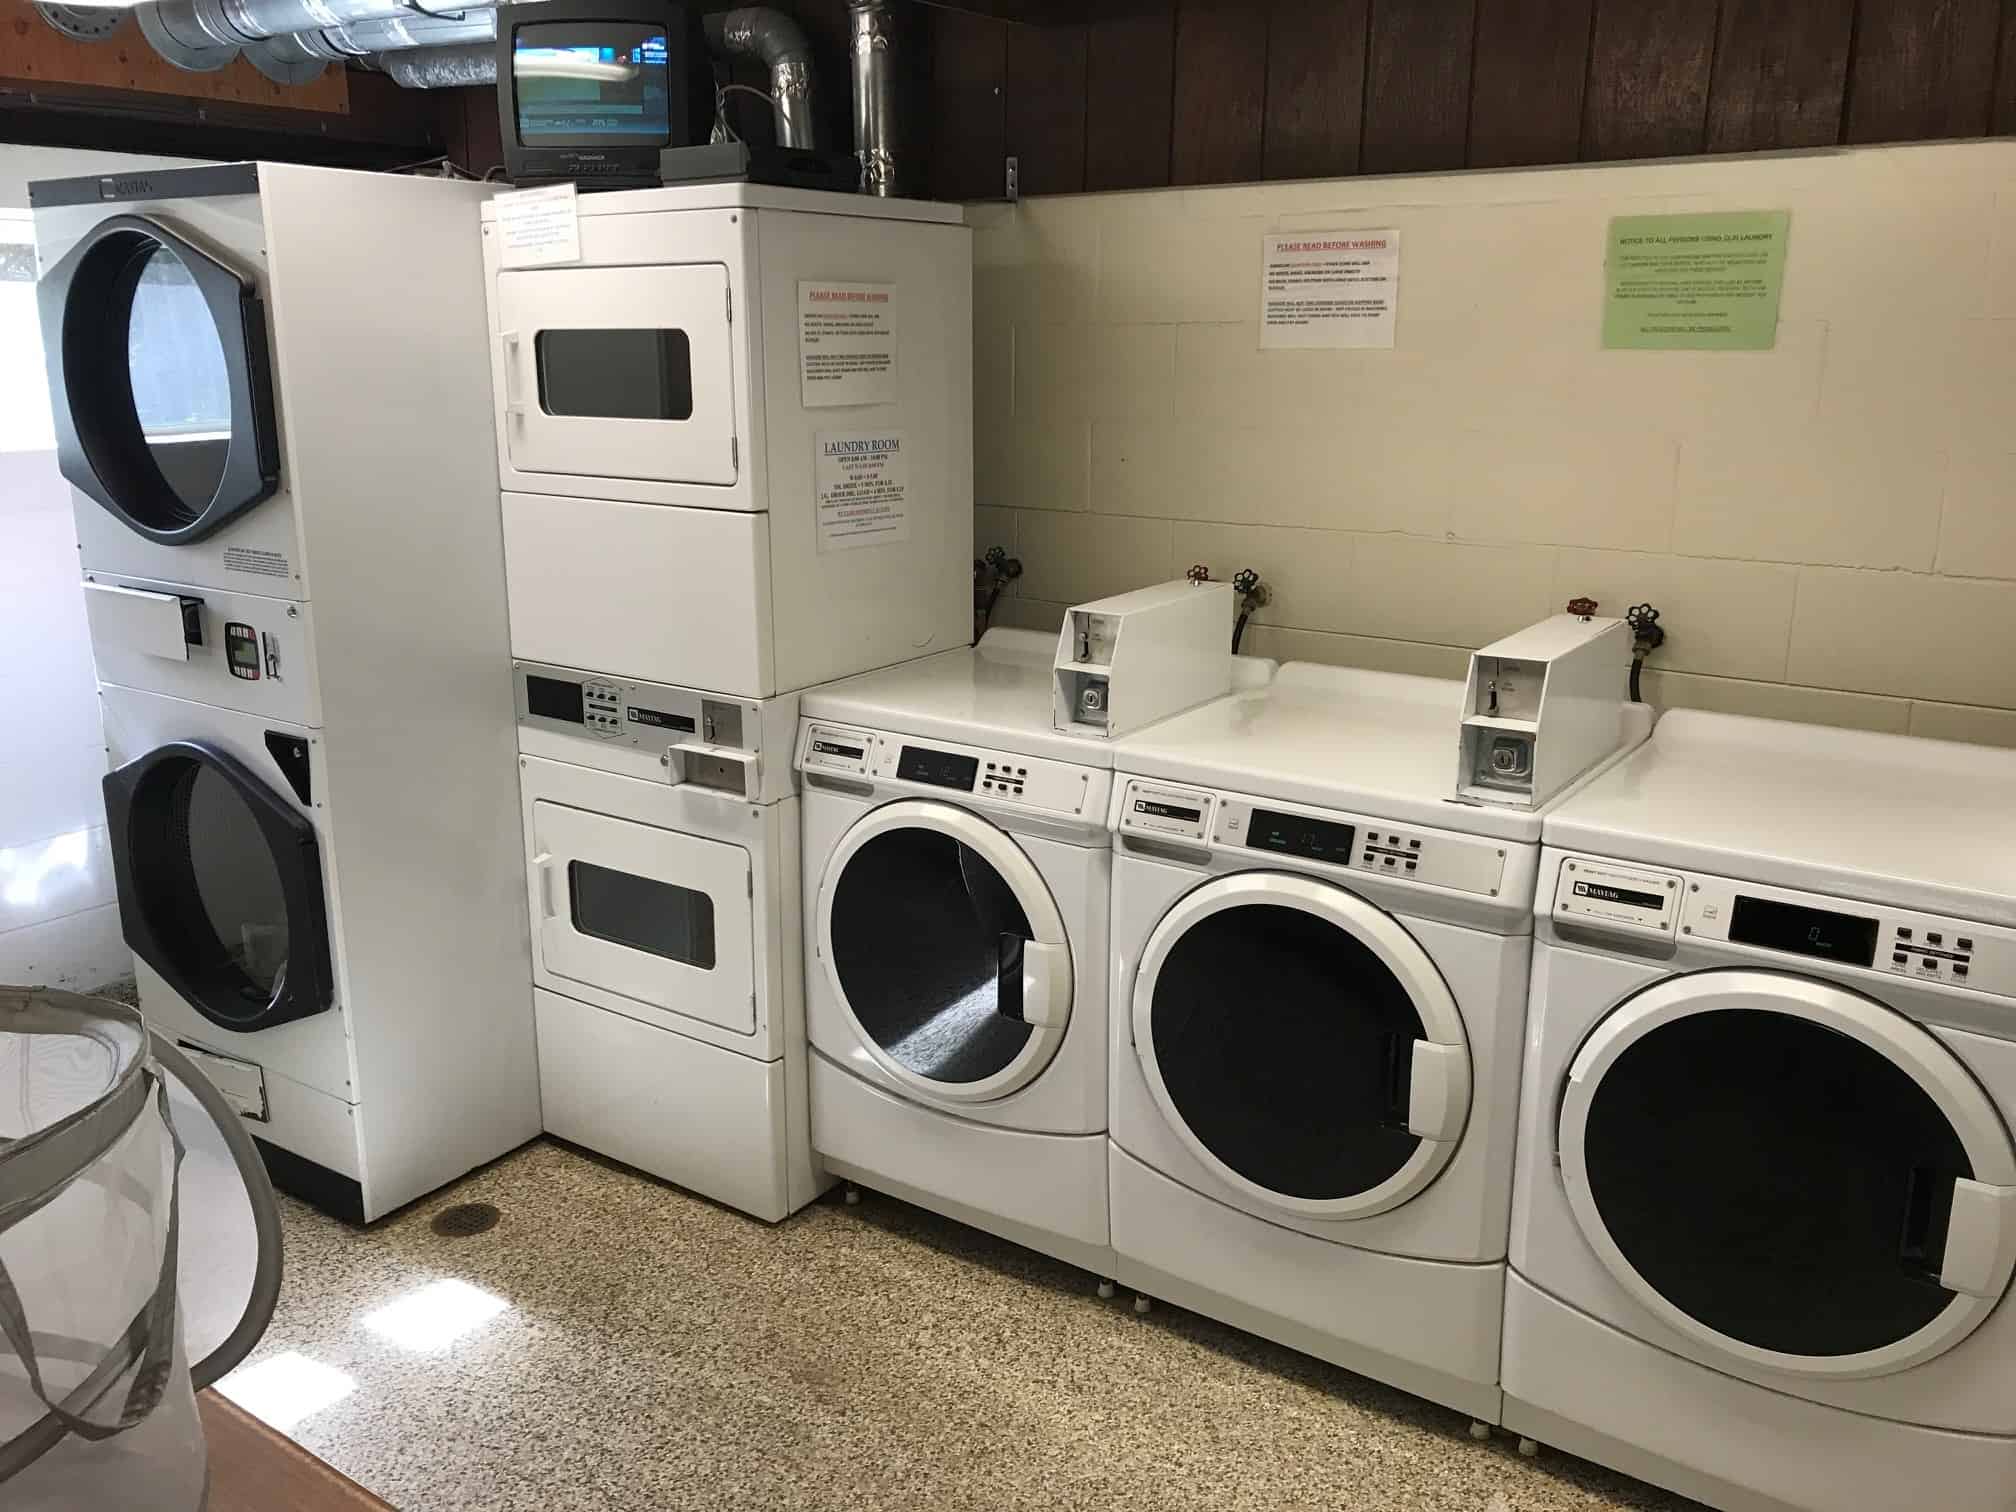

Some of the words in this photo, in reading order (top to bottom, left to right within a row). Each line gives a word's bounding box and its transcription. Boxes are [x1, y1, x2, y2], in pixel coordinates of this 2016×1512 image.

[1277, 242, 1301, 252] PLEASE
[1302, 241, 1322, 250] READ
[1323, 241, 1350, 250] BEFORE
[1351, 240, 1387, 249] WASHING
[824, 440, 871, 453] LAUNDRY
[871, 439, 900, 451] ROOM
[1588, 887, 1618, 899] MAYTAG
